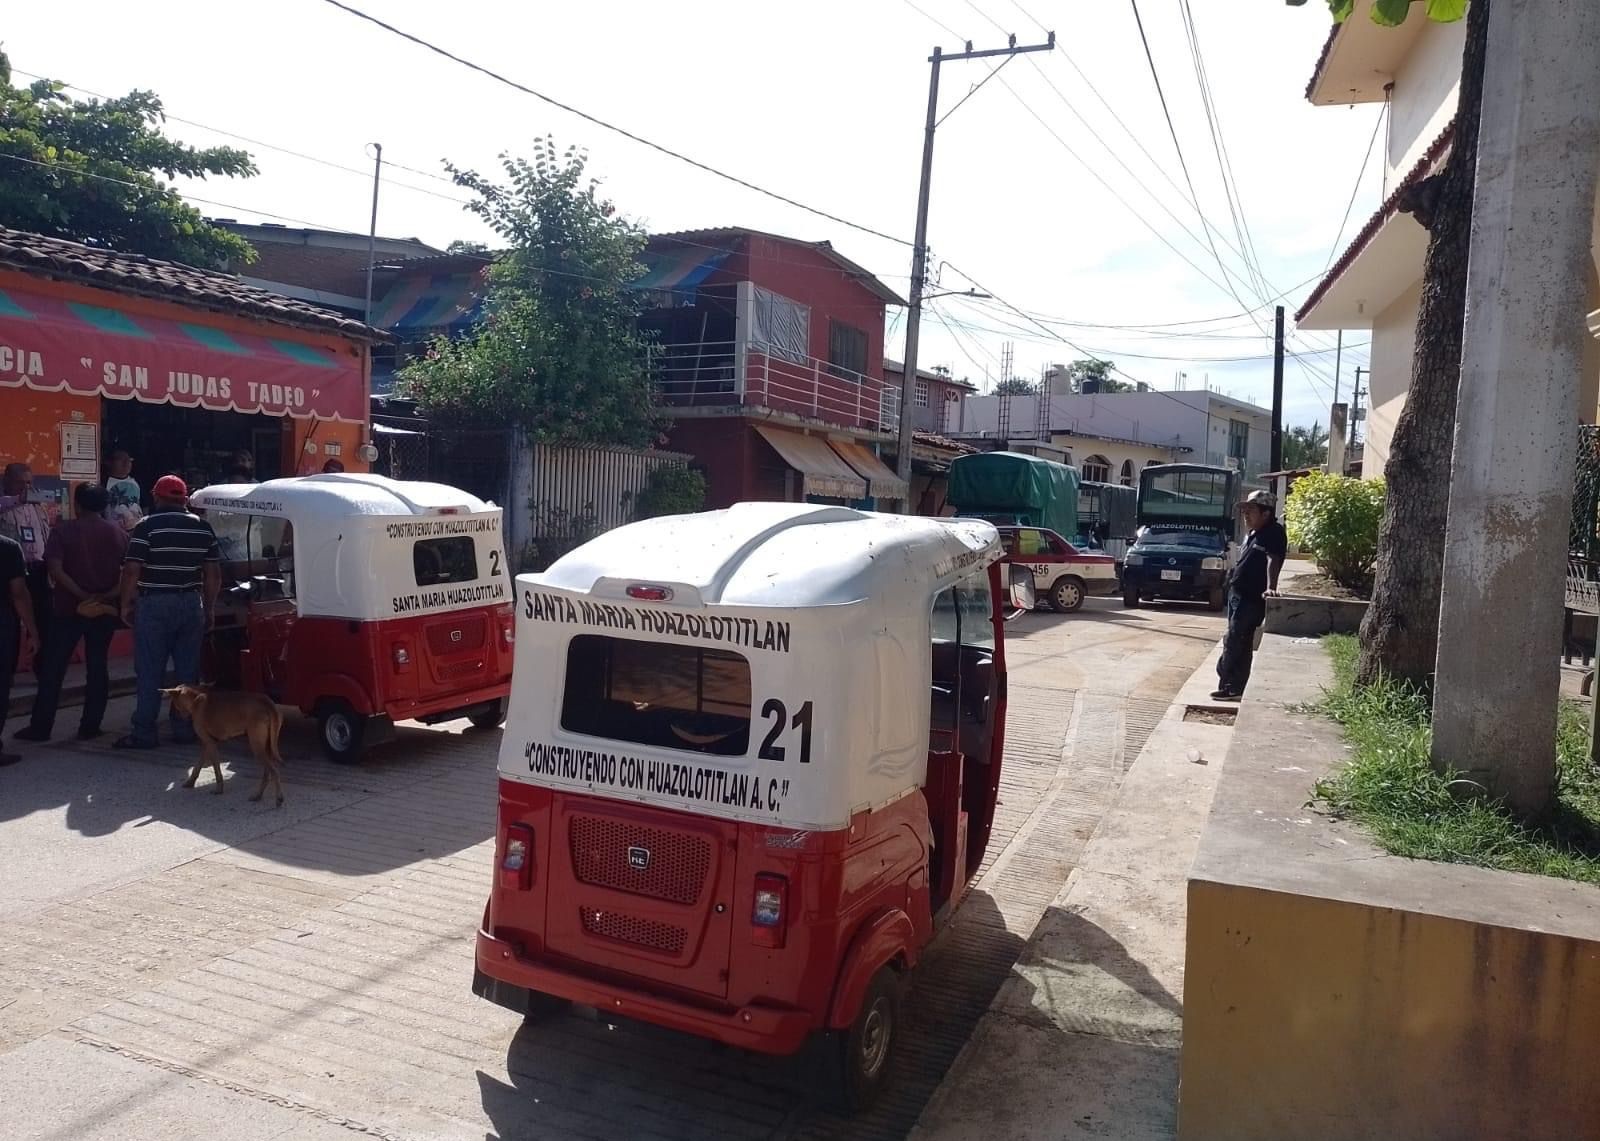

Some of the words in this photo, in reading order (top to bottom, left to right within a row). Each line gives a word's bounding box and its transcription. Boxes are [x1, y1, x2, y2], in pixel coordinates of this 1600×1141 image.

[167, 371, 231, 399] JUDAS
[392, 595, 421, 613] SANTA
[421, 591, 447, 608] MARIA
[447, 584, 504, 604] HUAZOLOTITLAN
[525, 590, 578, 623] SANTA
[582, 600, 636, 631] MARIA
[639, 608, 791, 653] HUAZOLOTITLAN
[757, 698, 814, 763] 21
[619, 755, 644, 784] CON
[647, 760, 749, 808] HUAZOLOTITLAN
